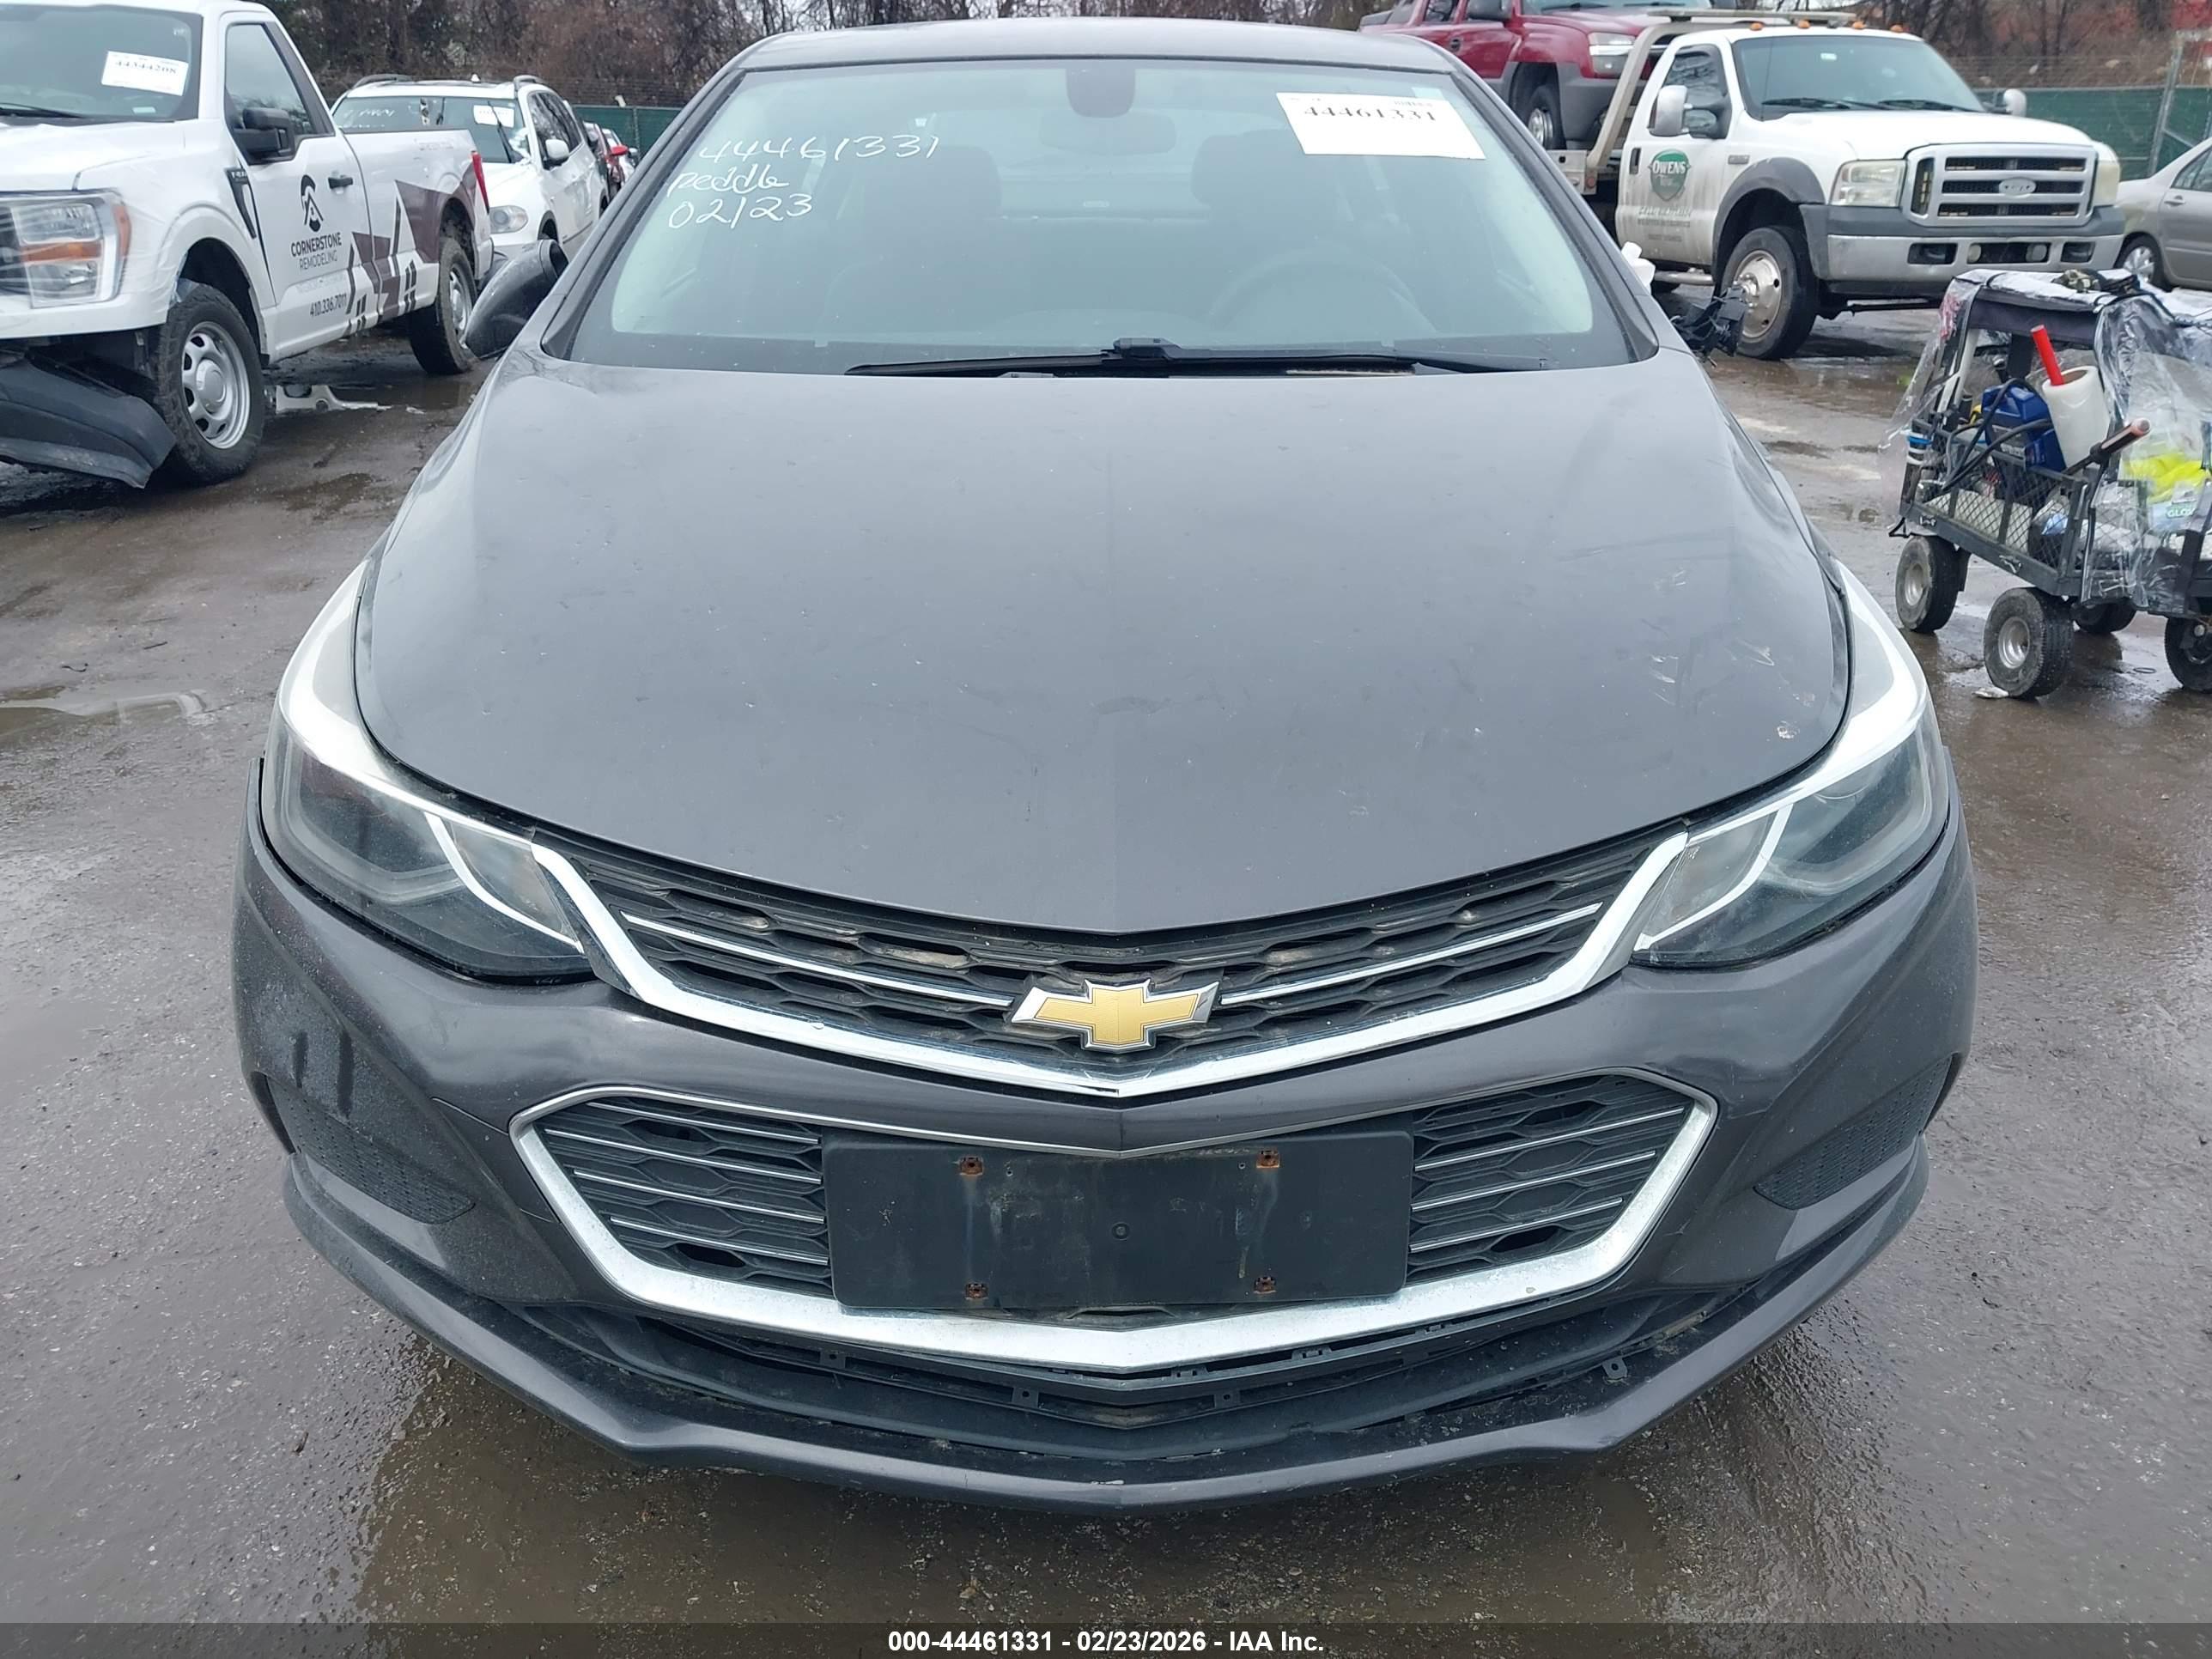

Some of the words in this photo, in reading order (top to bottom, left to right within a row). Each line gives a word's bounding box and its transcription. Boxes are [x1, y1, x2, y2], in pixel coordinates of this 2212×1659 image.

[1303, 106, 1437, 121] 44461331
[699, 135, 939, 161] 44461331
[1652, 161, 1687, 174] OWENS
[667, 193, 813, 229] 02/23
[290, 231, 343, 258] CORNERSTONE
[299, 249, 338, 270] REMODELING
